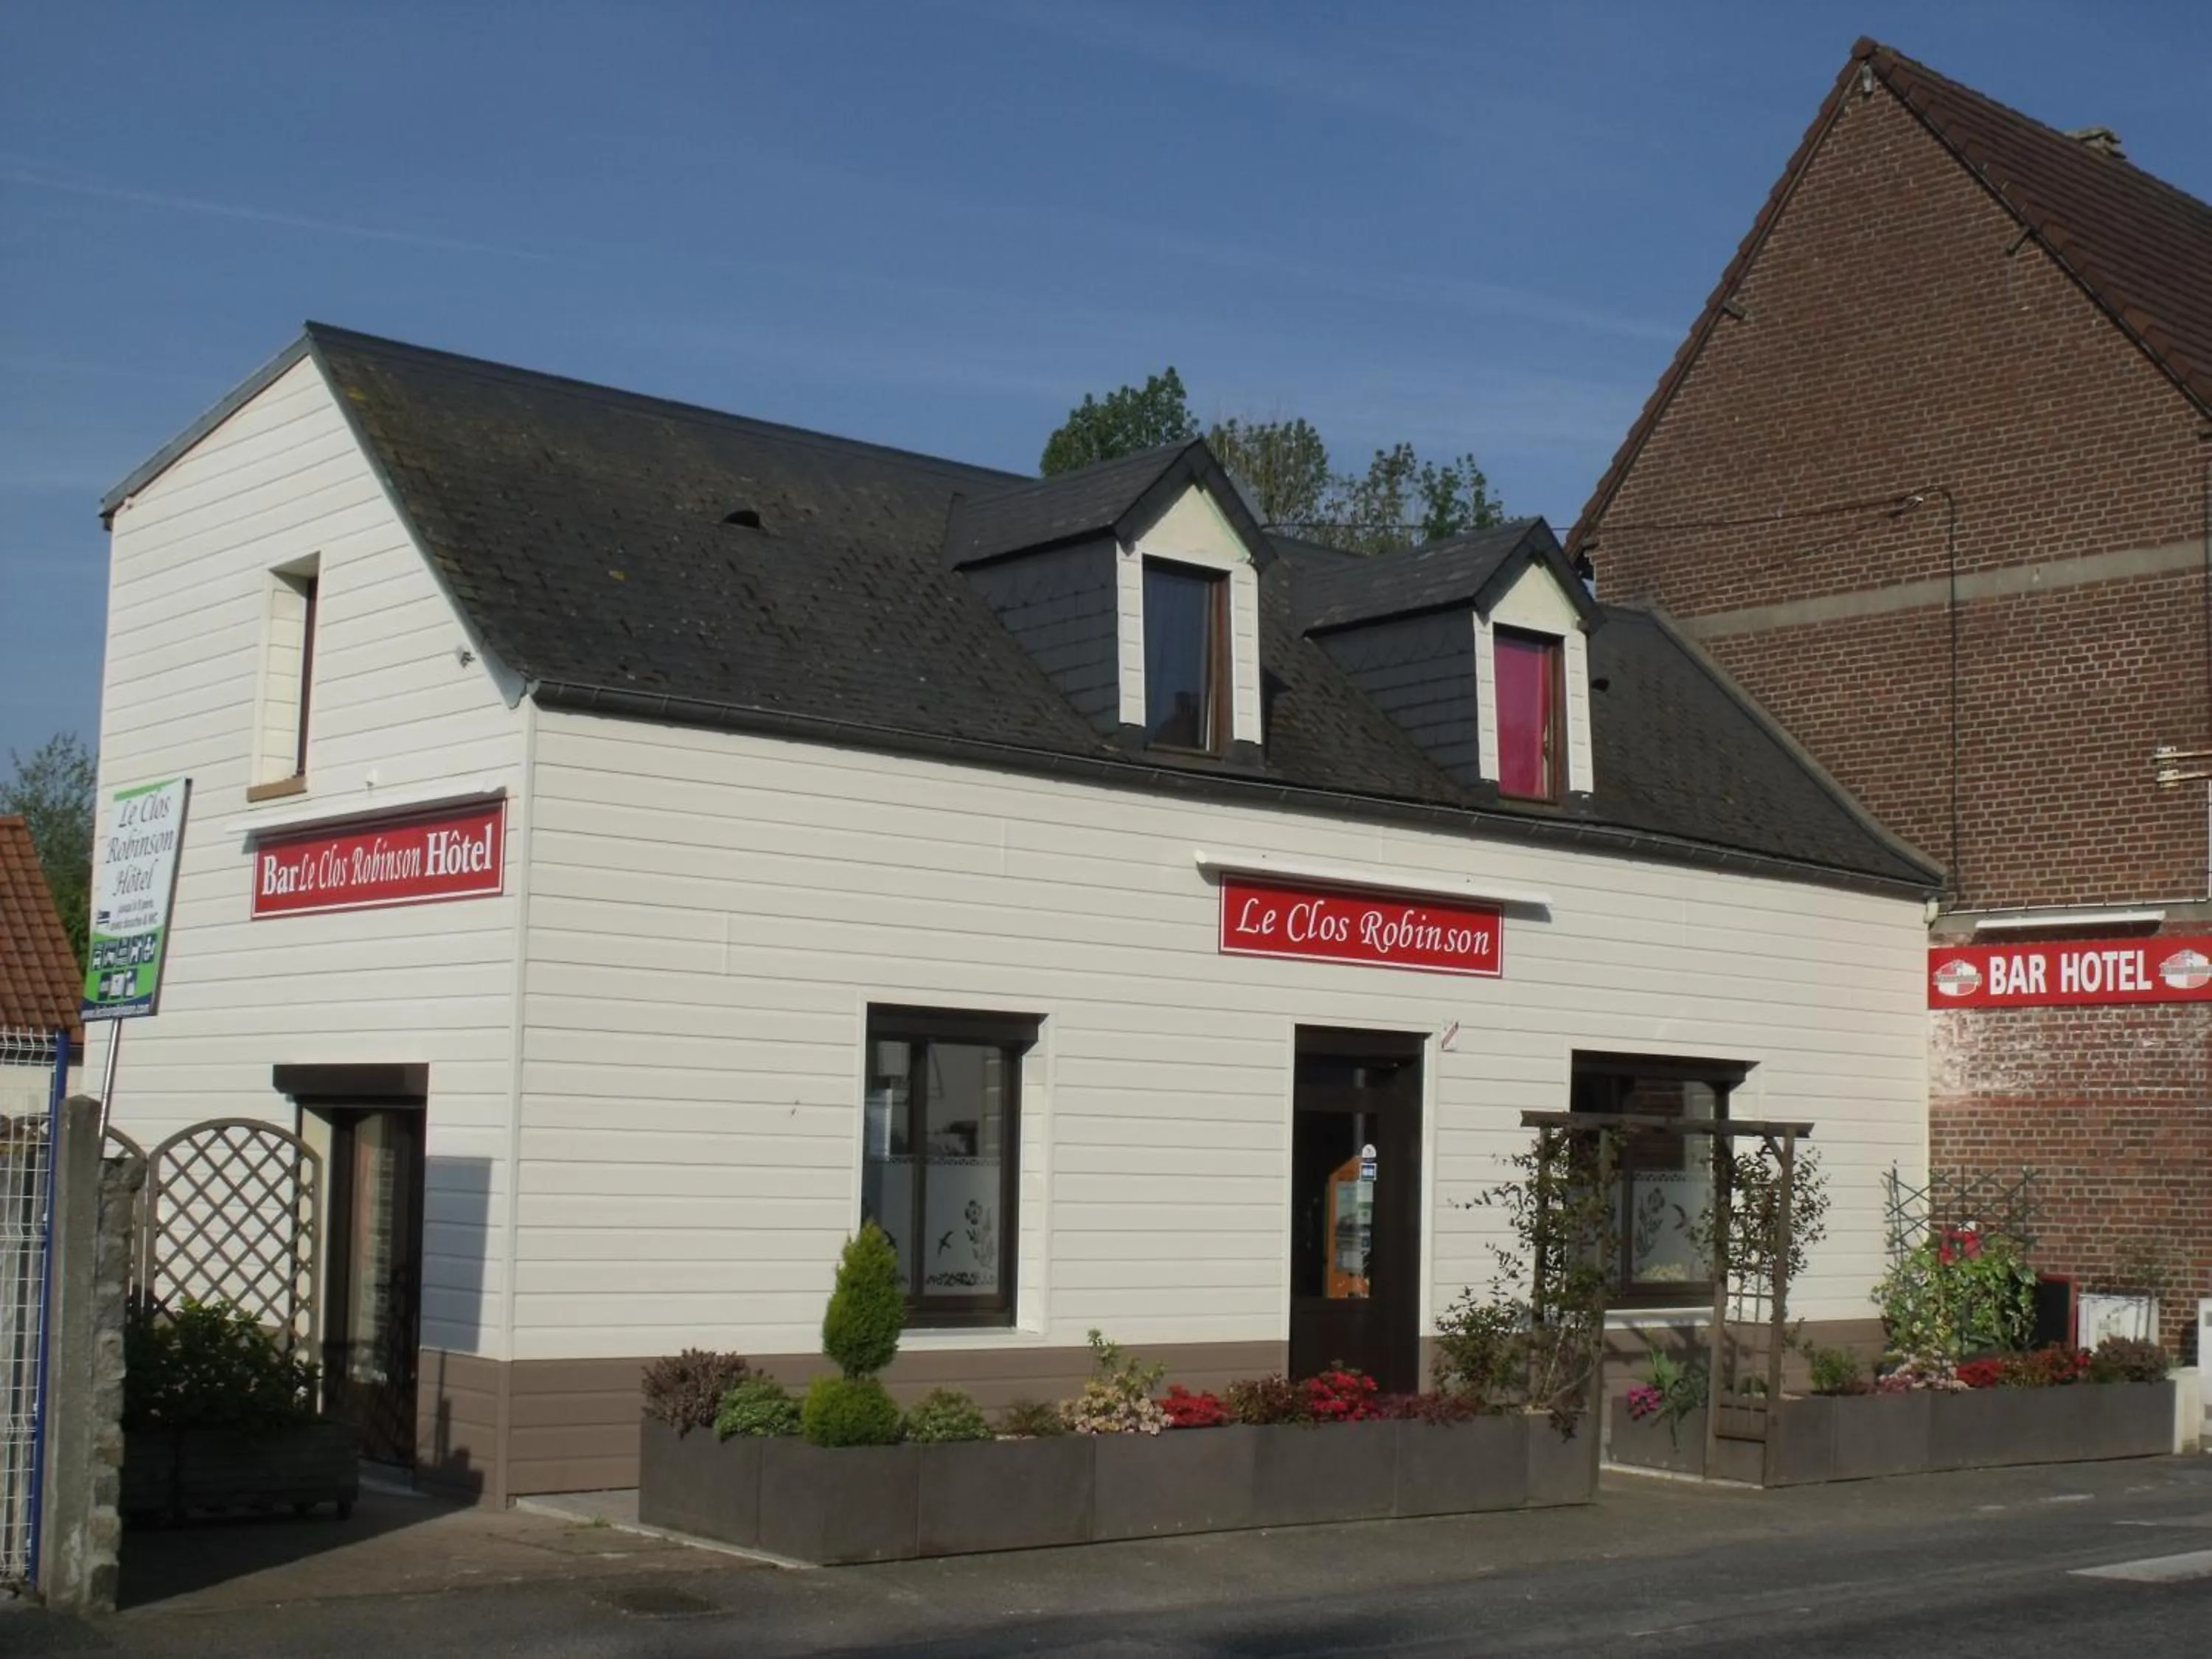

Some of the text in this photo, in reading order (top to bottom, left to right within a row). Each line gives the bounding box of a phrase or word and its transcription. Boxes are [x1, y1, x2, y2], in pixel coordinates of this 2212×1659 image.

[118, 791, 171, 827] Le Clos
[106, 828, 173, 863] Robinson
[261, 822, 493, 895] Bar Le Clos Robinson Hôtel
[1236, 897, 1490, 955] Le Clos Robinson
[1989, 950, 2153, 995] BAR HOTEL
